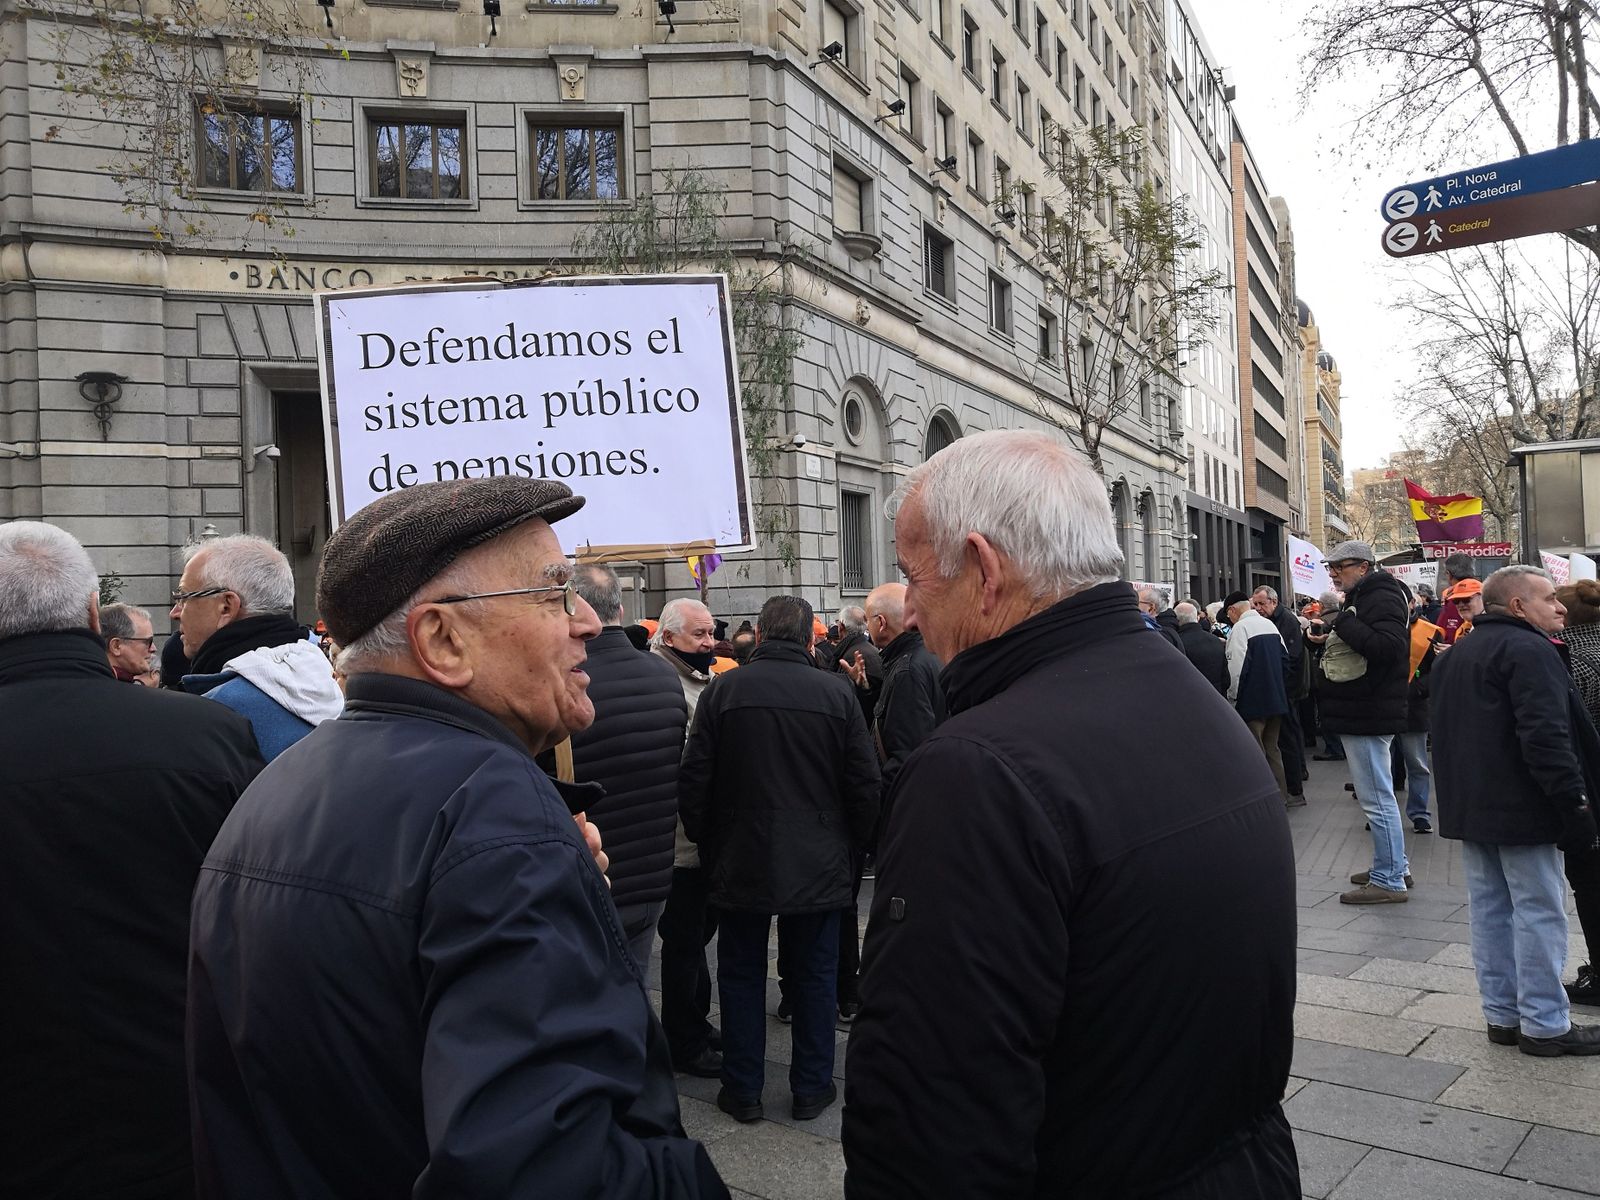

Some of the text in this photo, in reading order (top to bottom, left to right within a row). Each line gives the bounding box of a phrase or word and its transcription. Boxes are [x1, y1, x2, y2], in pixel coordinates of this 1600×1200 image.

[1446, 171, 1497, 190] Pl. Nova
[1448, 179, 1522, 206] Av. Catedral
[1448, 218, 1491, 233] Catedral
[245, 264, 374, 290] BANCO
[358, 316, 684, 370] Defendamos el
[364, 377, 700, 432] sistema público
[368, 440, 660, 493] de pensiones.
[1434, 546, 1446, 557] el
